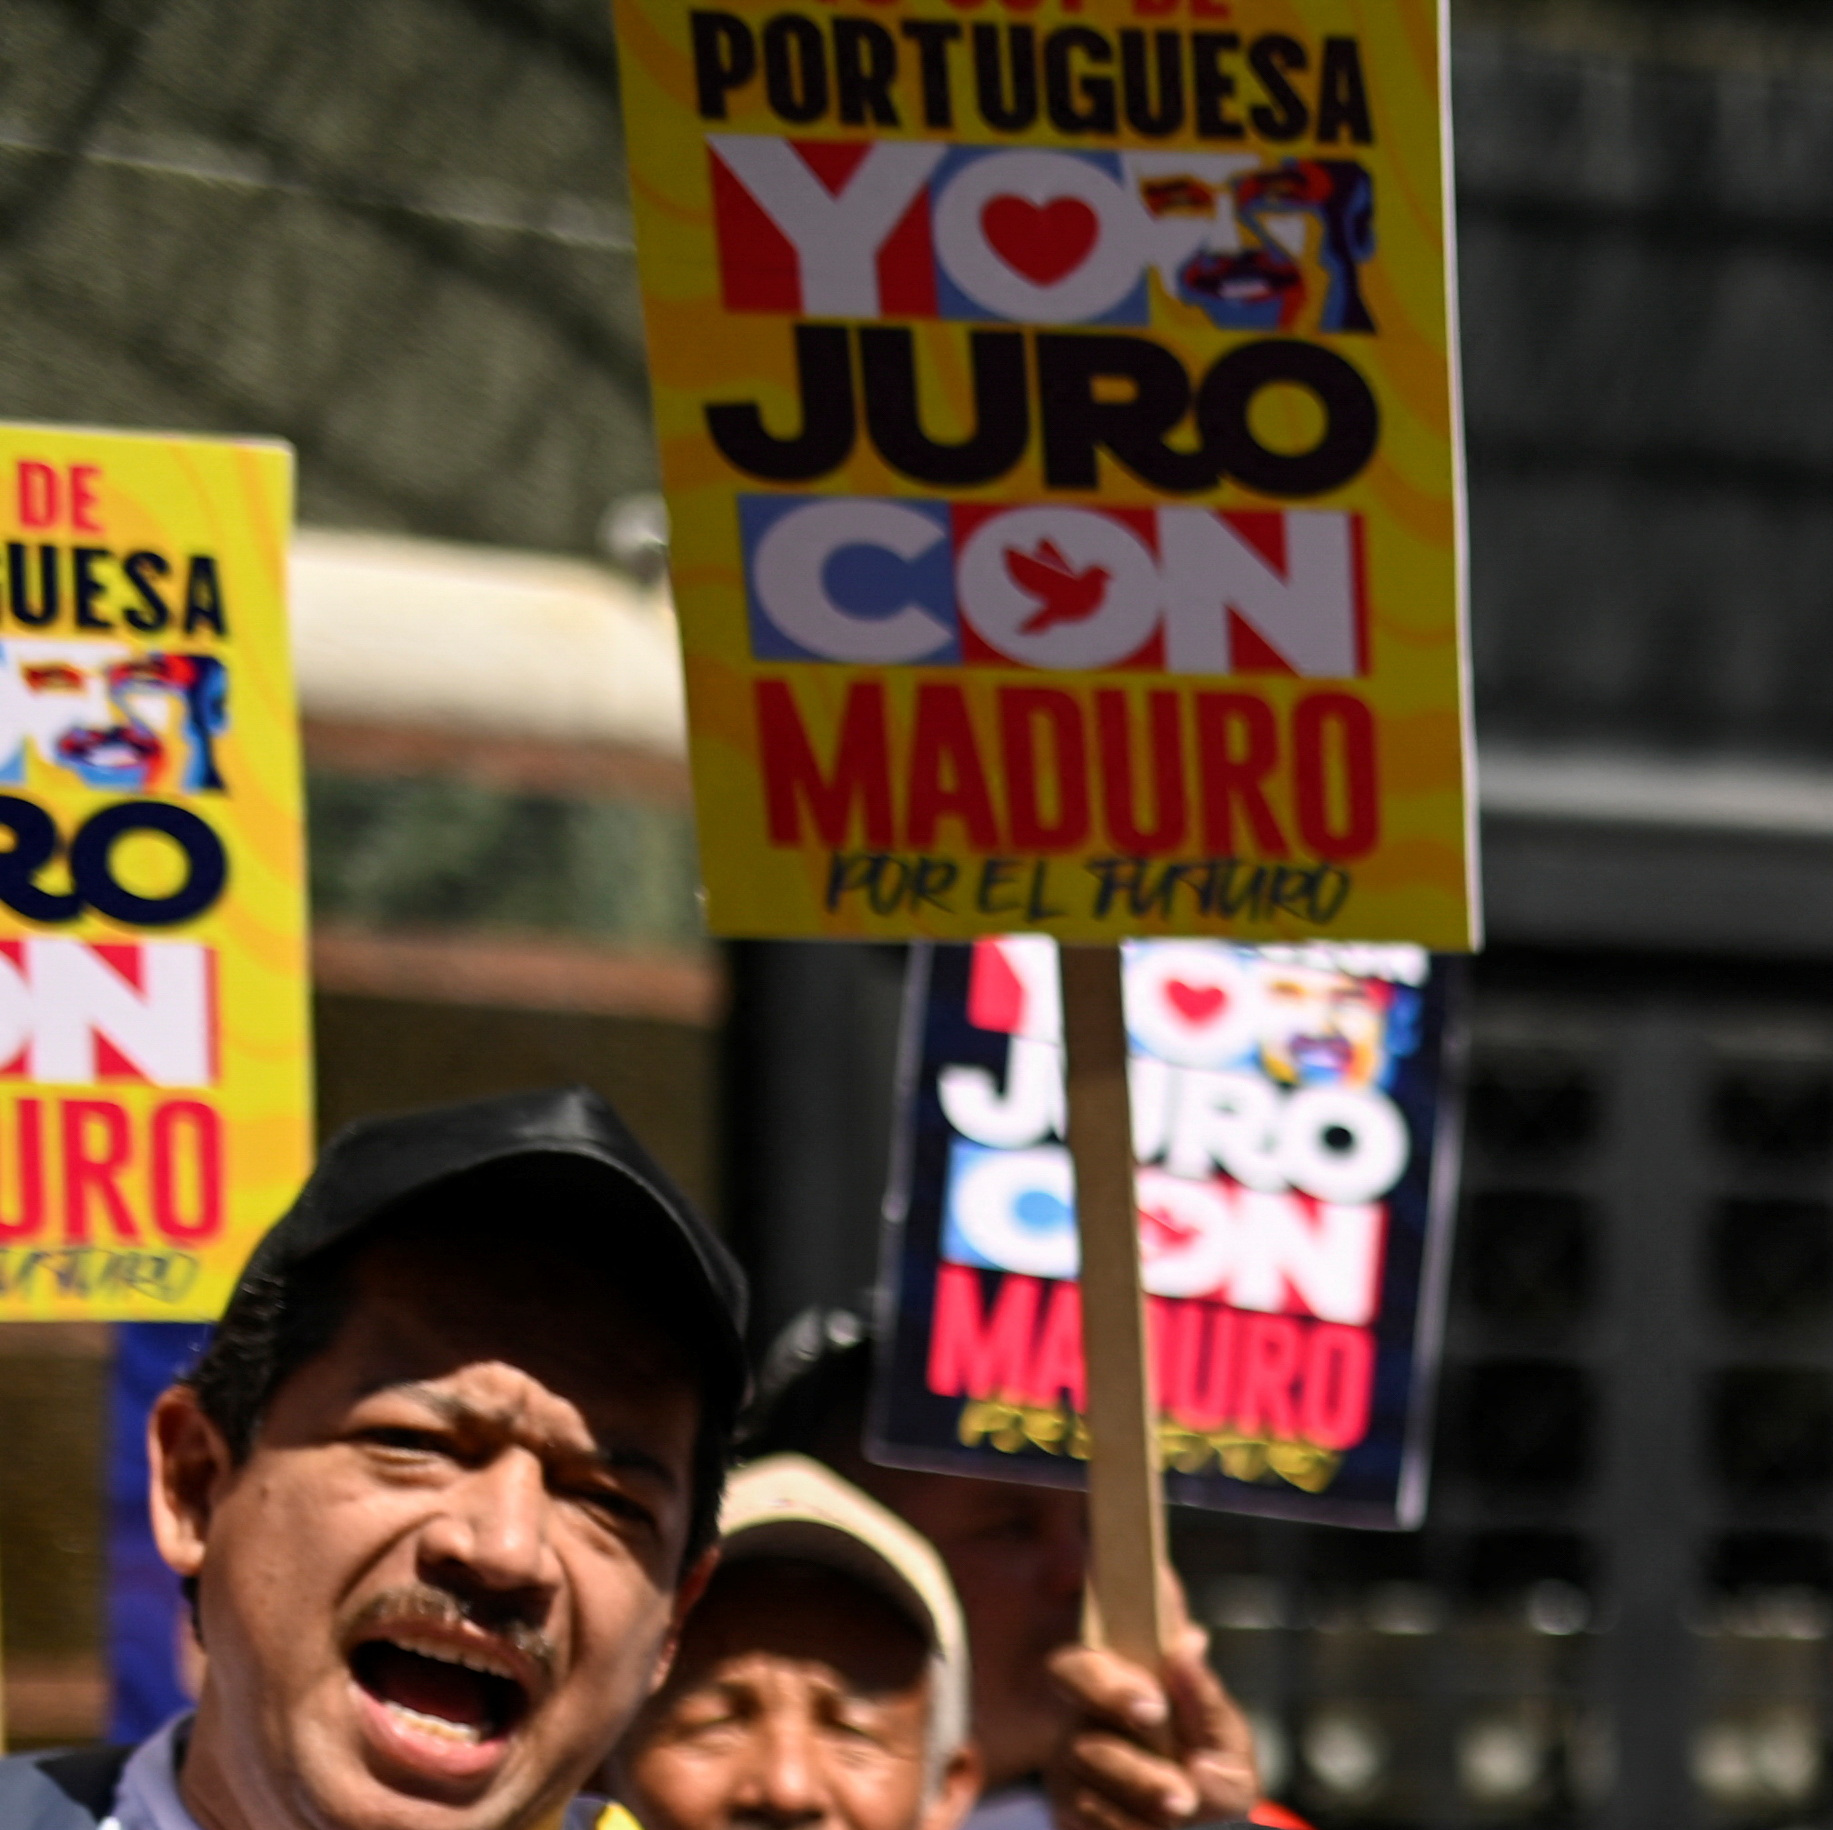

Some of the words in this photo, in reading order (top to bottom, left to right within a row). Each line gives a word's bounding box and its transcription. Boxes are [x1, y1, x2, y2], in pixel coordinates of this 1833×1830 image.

[690, 10, 1375, 146] PORTUGUESA
[703, 134, 1155, 324] YO
[703, 322, 1380, 497] JURO
[15, 458, 105, 536] DE
[0, 540, 230, 640] UESA
[750, 498, 1360, 678] CON
[752, 676, 1381, 862] MADURO
[825, 852, 957, 918] POR
[976, 856, 1069, 922] EL
[1085, 857, 1353, 926] FUTURO
